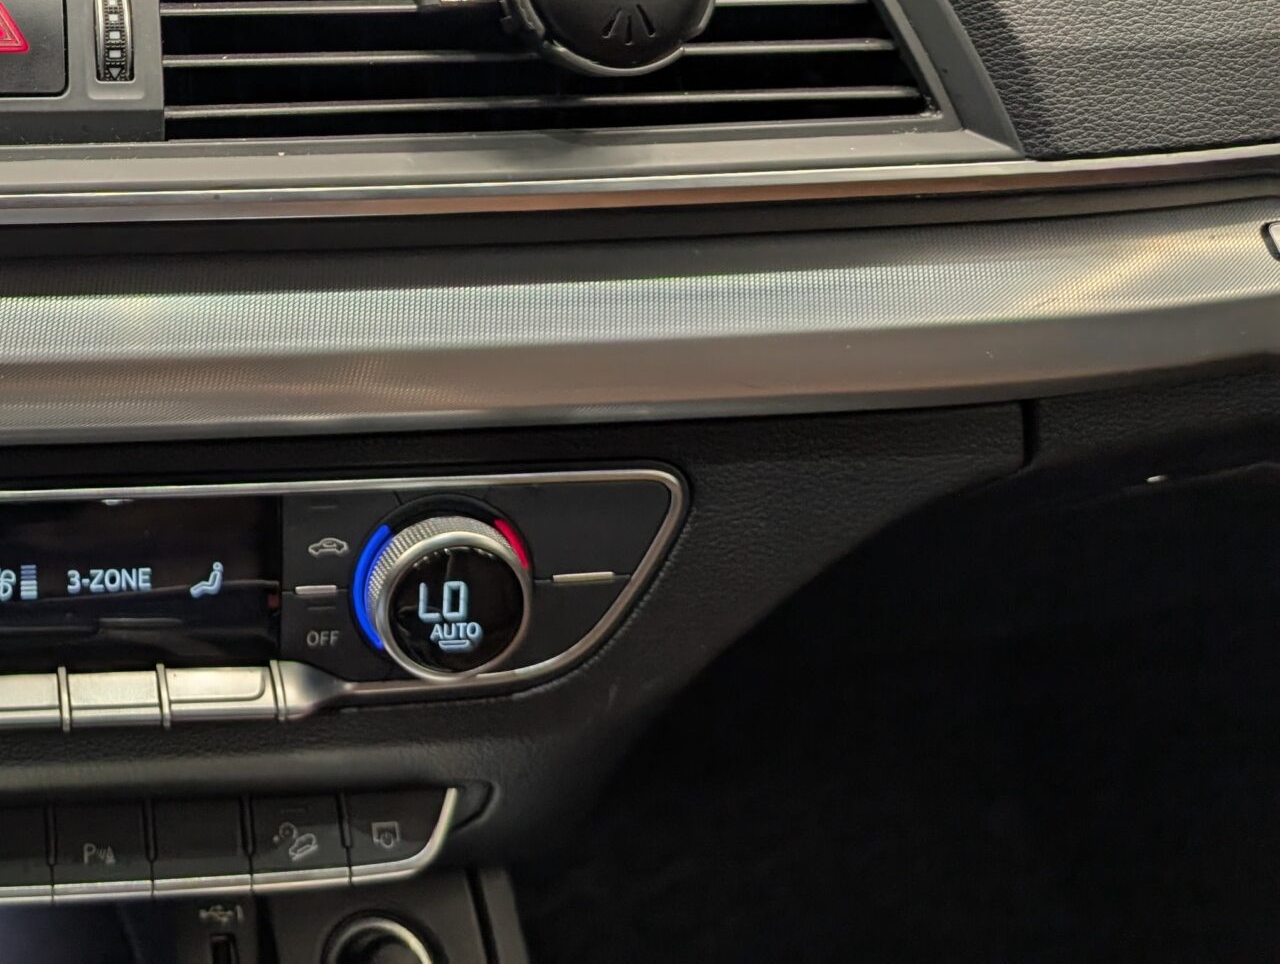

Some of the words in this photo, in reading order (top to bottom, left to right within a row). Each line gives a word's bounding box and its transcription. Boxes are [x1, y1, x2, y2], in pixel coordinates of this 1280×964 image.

[68, 567, 152, 593] 3-ZONE
[419, 581, 468, 622] LO
[306, 630, 341, 647] OFF
[430, 622, 483, 640] AUTO
